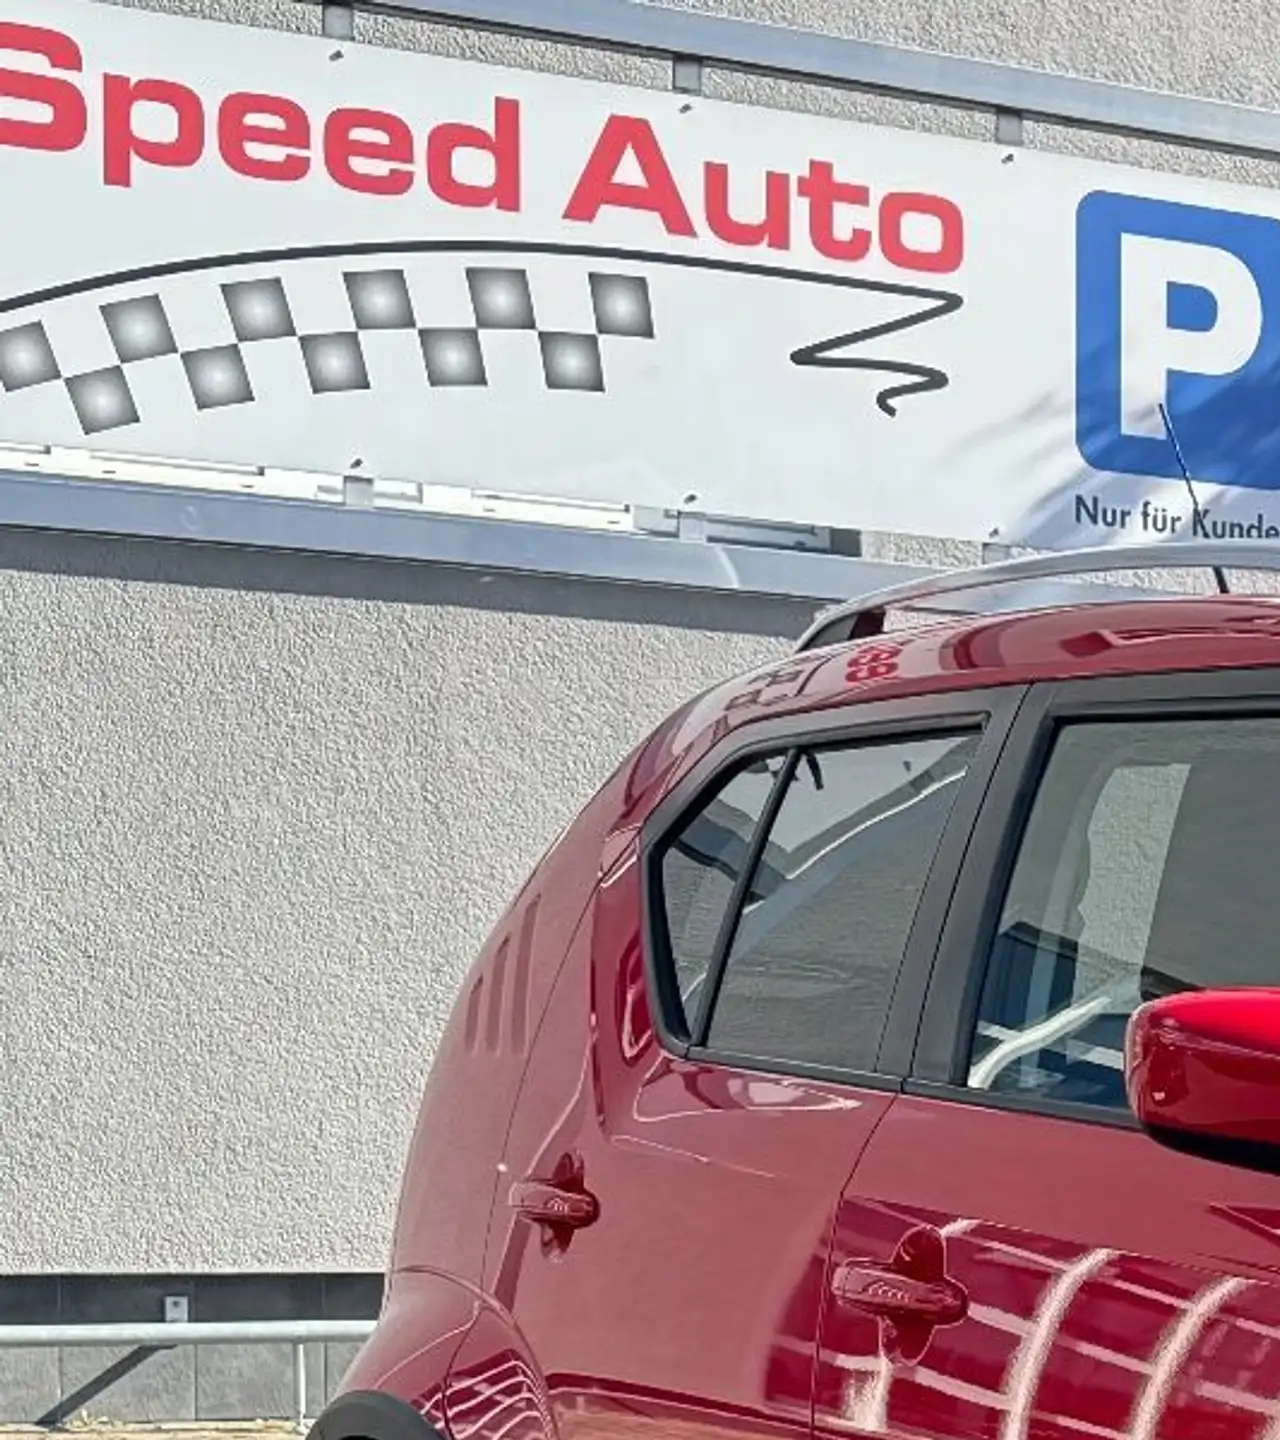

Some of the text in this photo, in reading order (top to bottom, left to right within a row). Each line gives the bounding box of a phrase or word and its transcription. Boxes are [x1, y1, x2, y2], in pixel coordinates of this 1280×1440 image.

[0, 22, 965, 274] Speed Auto
[1120, 230, 1263, 441] P
[1074, 494, 1131, 530] Nur
[1141, 501, 1181, 534] für
